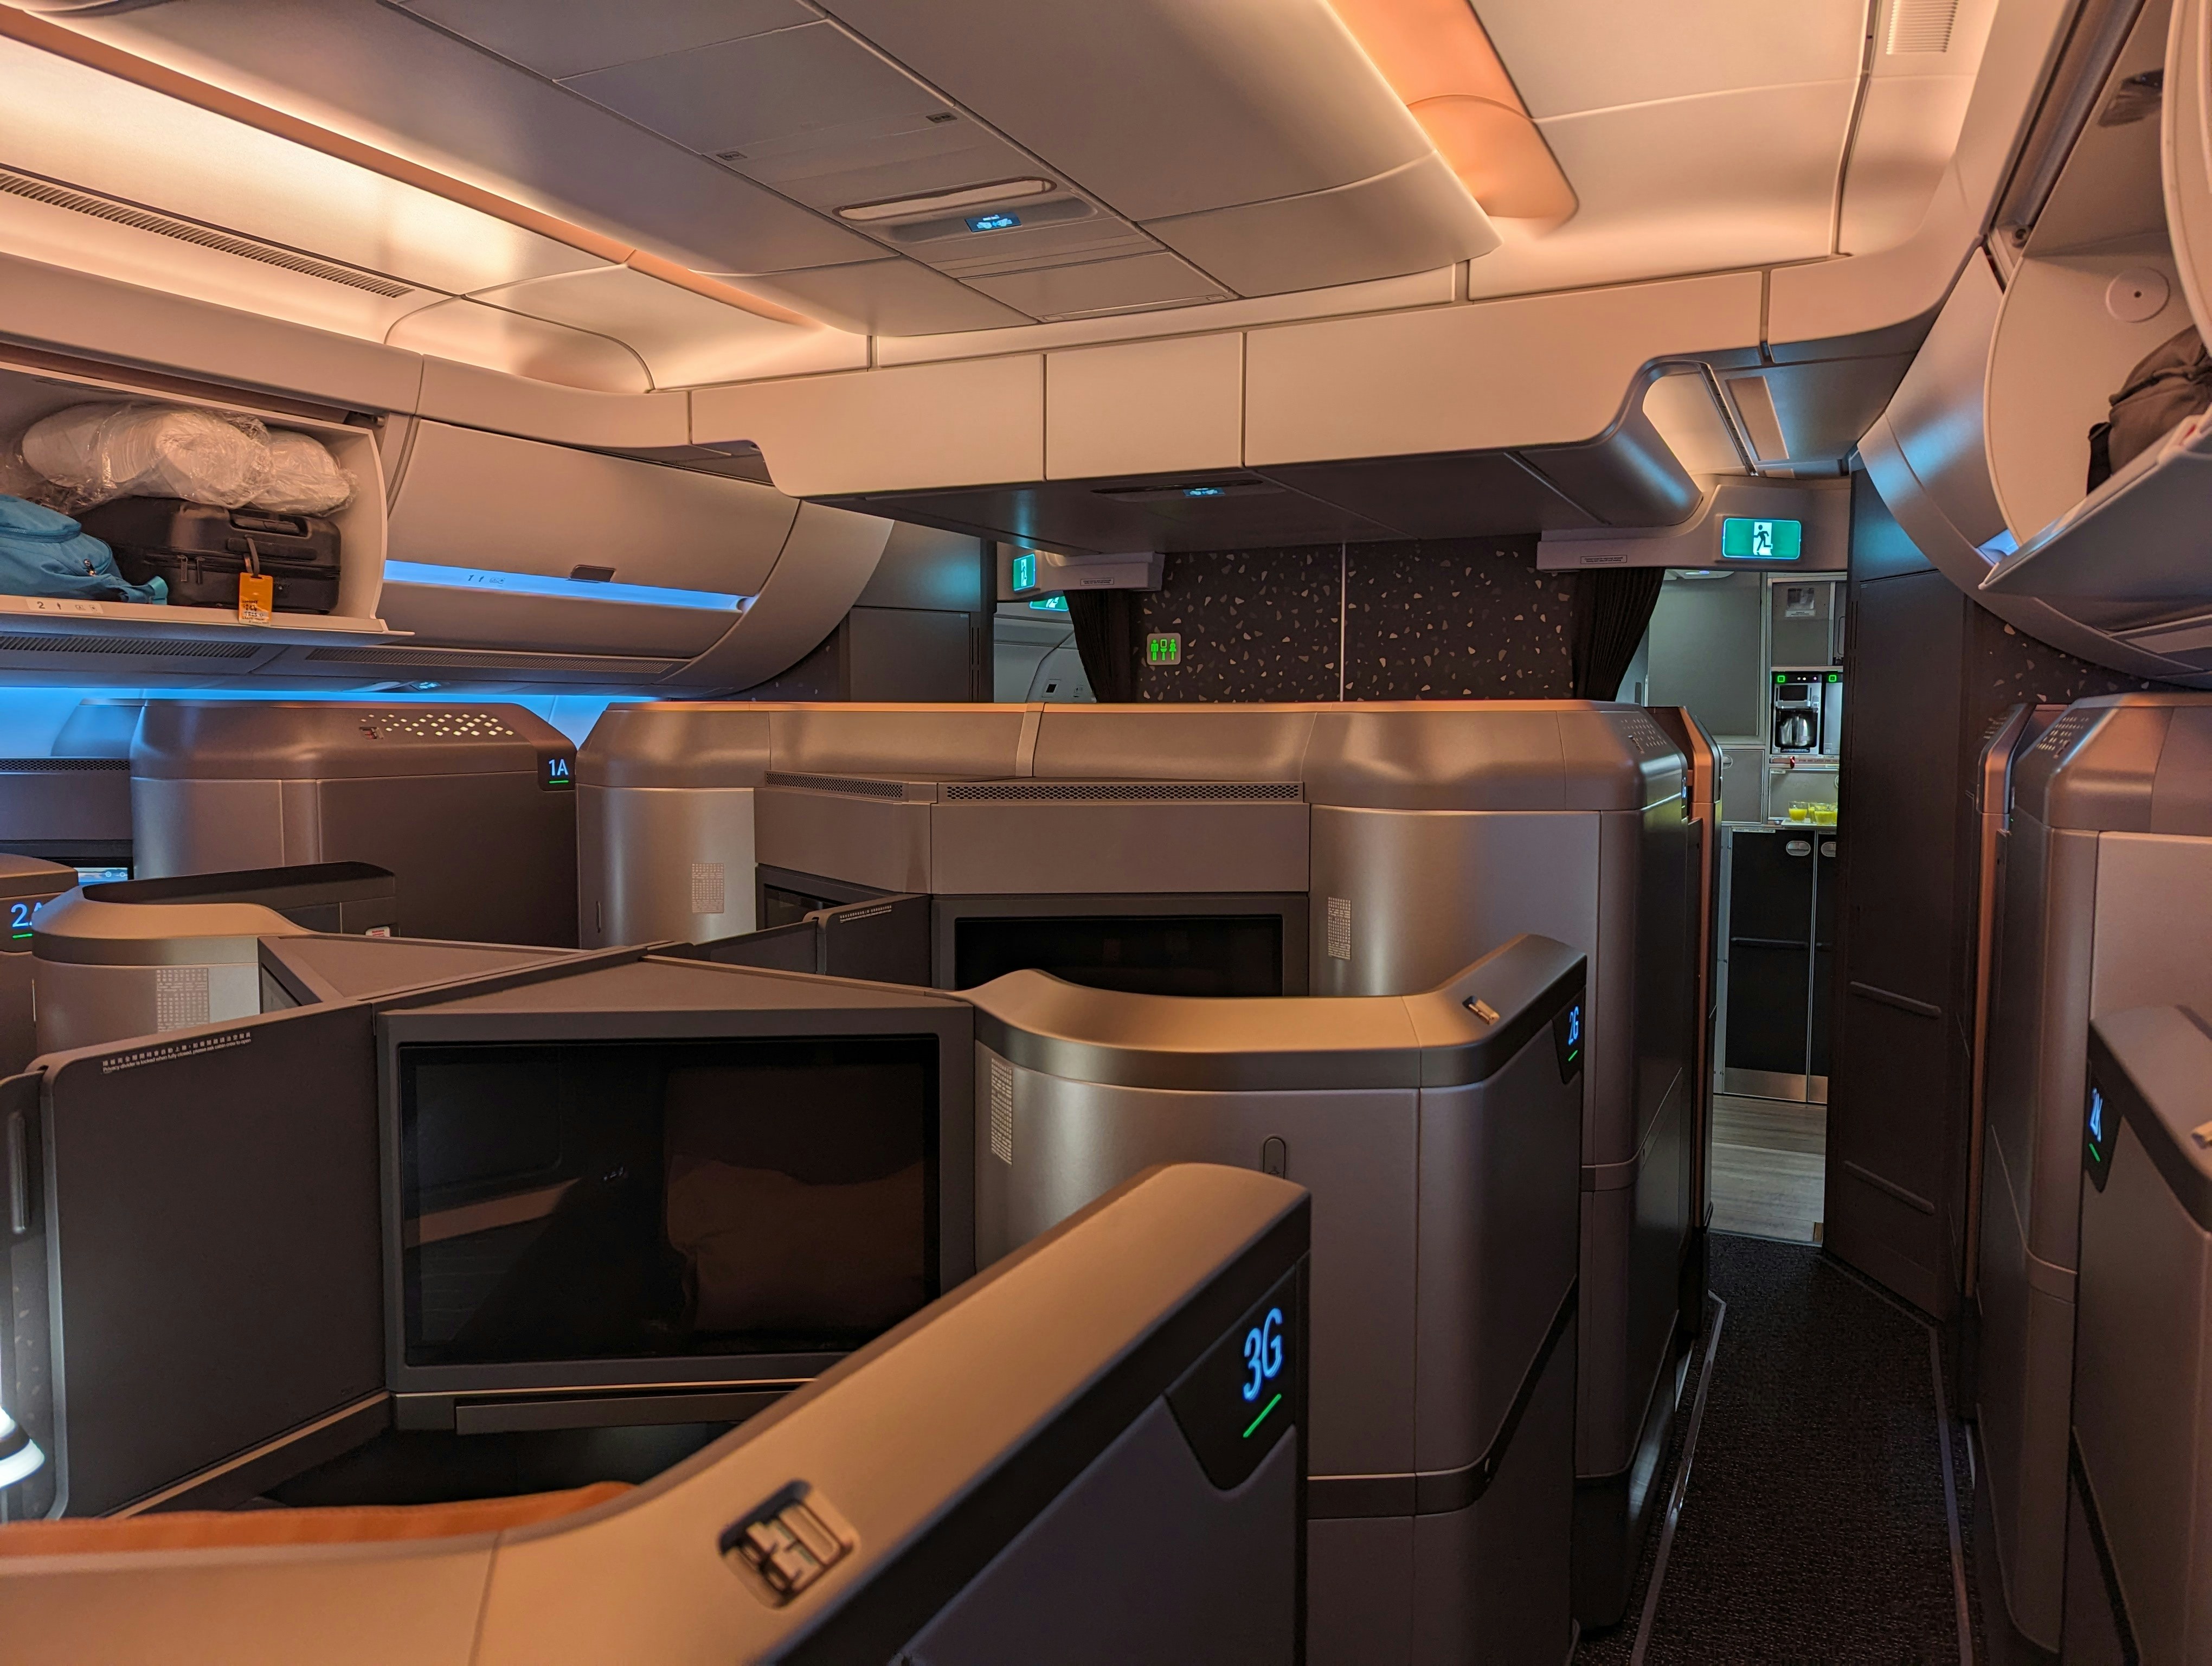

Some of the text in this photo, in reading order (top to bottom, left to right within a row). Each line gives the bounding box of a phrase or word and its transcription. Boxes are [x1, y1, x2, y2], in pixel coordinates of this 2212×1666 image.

[37, 601, 46, 609] 2
[548, 759, 569, 776] 1A
[1568, 1006, 1579, 1046] 2G
[1243, 1308, 1283, 1401] 3G
